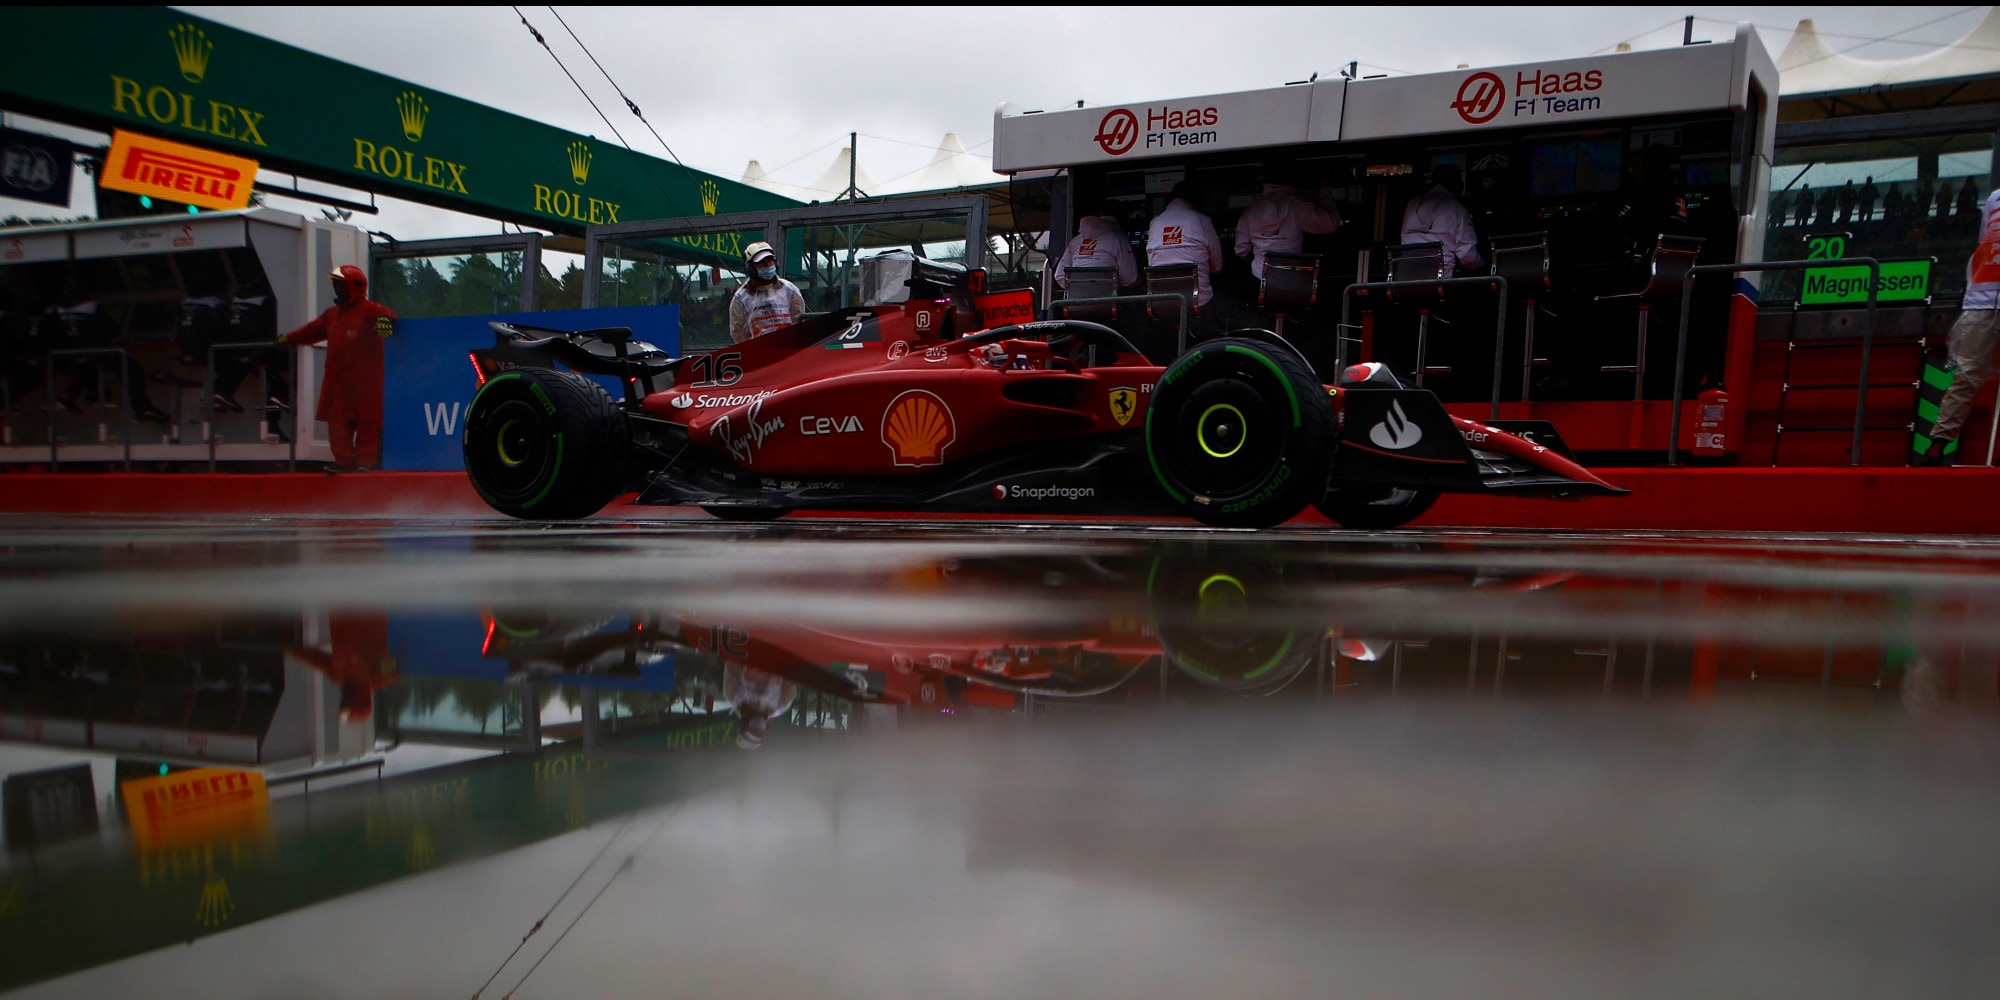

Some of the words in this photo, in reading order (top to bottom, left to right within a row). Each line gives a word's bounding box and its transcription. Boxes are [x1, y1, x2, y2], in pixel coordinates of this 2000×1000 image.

[1515, 69, 1603, 97] Haas
[111, 74, 268, 148] ROLEX
[1515, 97, 1537, 117] F1
[1542, 93, 1601, 114] Team
[1146, 106, 1219, 131] Haas
[1146, 131, 1165, 148] F1
[1169, 129, 1218, 146] Team
[122, 146, 241, 200] PIRELLI
[353, 137, 469, 195] ROLEX
[534, 183, 621, 224] ROLEX
[1807, 235, 1846, 260] 20
[978, 300, 1031, 321] humacher
[1025, 321, 1066, 331] Snapdragon
[925, 347, 948, 358] aws
[690, 352, 743, 388] 16
[695, 389, 778, 409] Santander
[1010, 484, 1095, 501] Snapdragon
